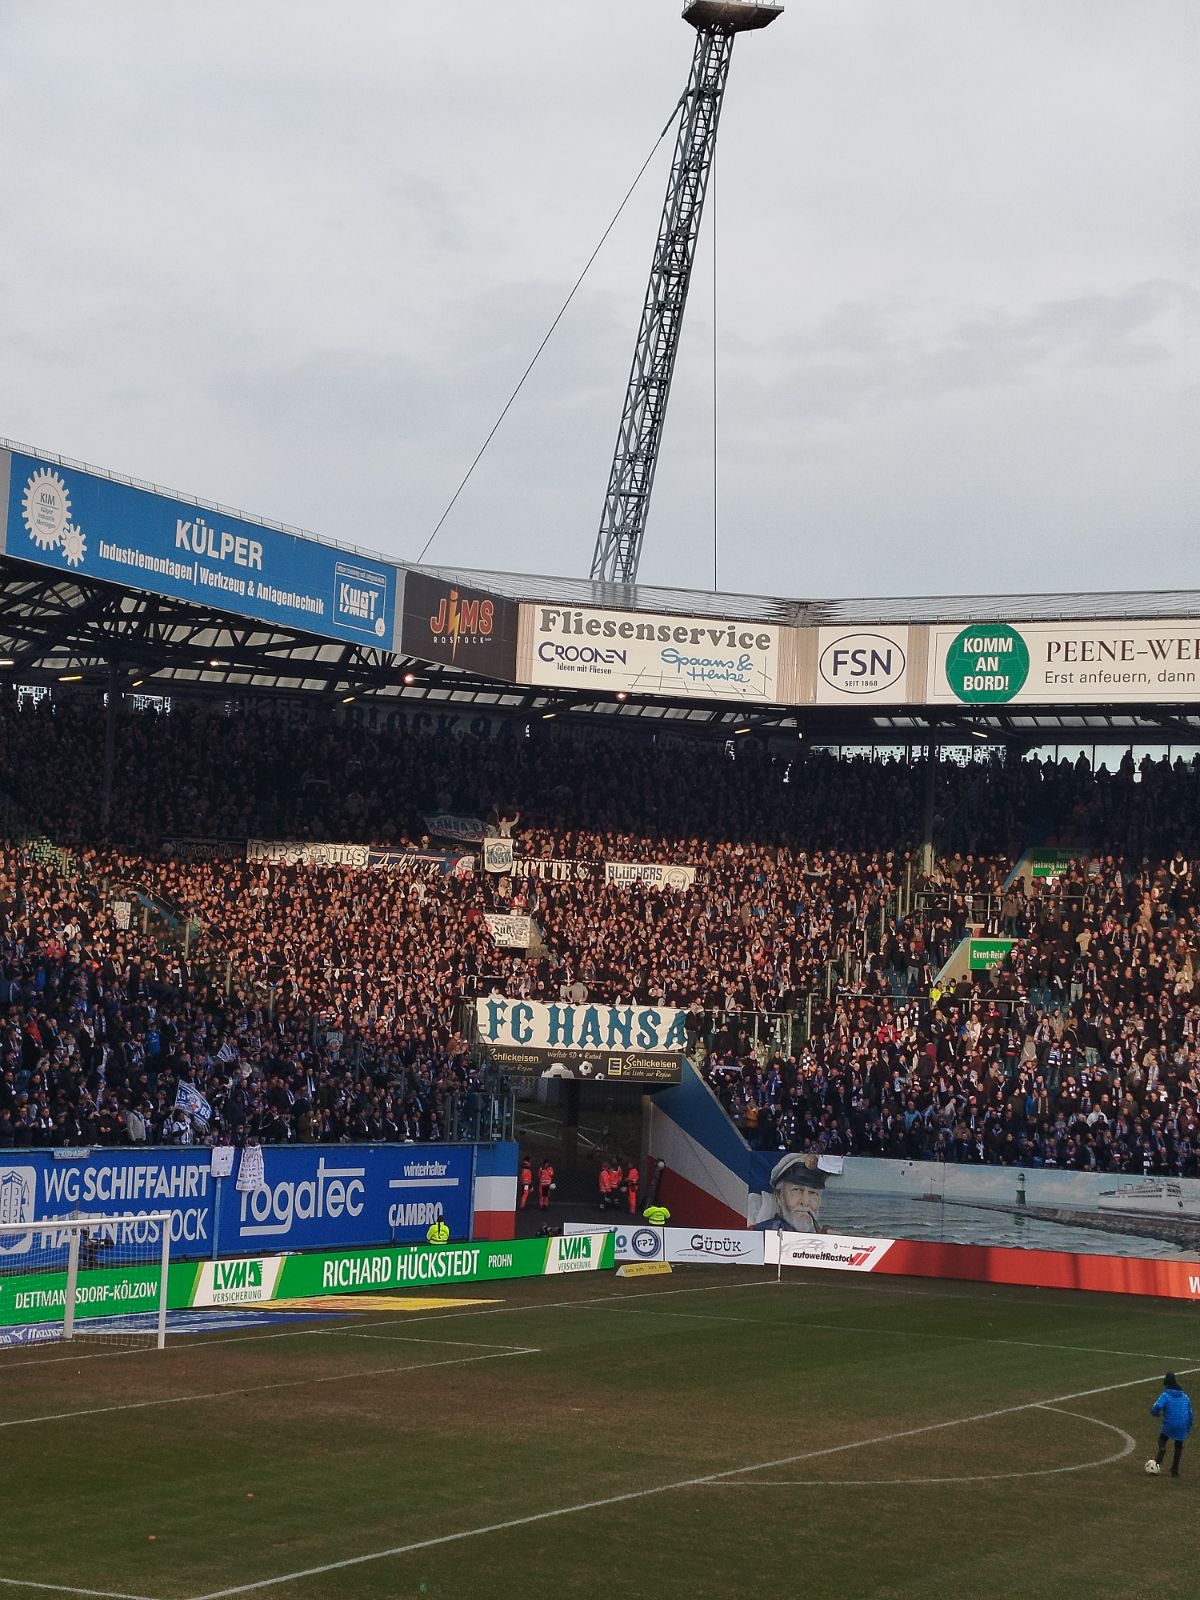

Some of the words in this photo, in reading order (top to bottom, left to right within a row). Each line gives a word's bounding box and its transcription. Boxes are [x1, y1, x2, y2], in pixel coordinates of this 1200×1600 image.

[41, 492, 55, 506] KIM
[175, 517, 263, 571] KÜLPER
[99, 540, 192, 581] Industriemontagen
[200, 566, 245, 596] Werkzeug
[247, 580, 254, 597] &
[256, 582, 324, 615] Anlagentechnik
[539, 608, 771, 650] Fliesenservice
[433, 636, 484, 644] ROSTOCK
[963, 637, 1012, 653] KOMM
[538, 641, 626, 665] CROONEN
[557, 662, 575, 673] Ideen
[577, 664, 587, 674] mit
[589, 665, 612, 675] Fliesen
[736, 654, 753, 671] &
[832, 650, 892, 676] FSN
[976, 657, 998, 672] AN
[963, 676, 1009, 691] BORD!
[1045, 671, 1074, 683] Erst
[1080, 670, 1151, 684] anfeuern,
[1158, 670, 1195, 682] dann
[485, 999, 534, 1044] FC
[547, 1003, 688, 1049] HANSA
[623, 1055, 678, 1070] Schlickeisen
[403, 1161, 447, 1177] winterhalter
[43, 1168, 80, 1202] WG
[82, 1165, 211, 1201] SCHIFFAHRT
[388, 1202, 443, 1227] CAMBRO
[122, 1208, 209, 1245] ROSTOCK
[690, 1234, 741, 1252] GÜDÜK
[322, 1255, 392, 1287] RICHARD
[396, 1247, 480, 1280] HÜCKSTEDT
[488, 1254, 513, 1268] PROHN
[558, 1260, 591, 1272] VERSICHERUNG
[15, 1280, 157, 1309] DETTMANSDORF-KÖLZOW
[212, 1289, 262, 1302] VERSICHERUNG
